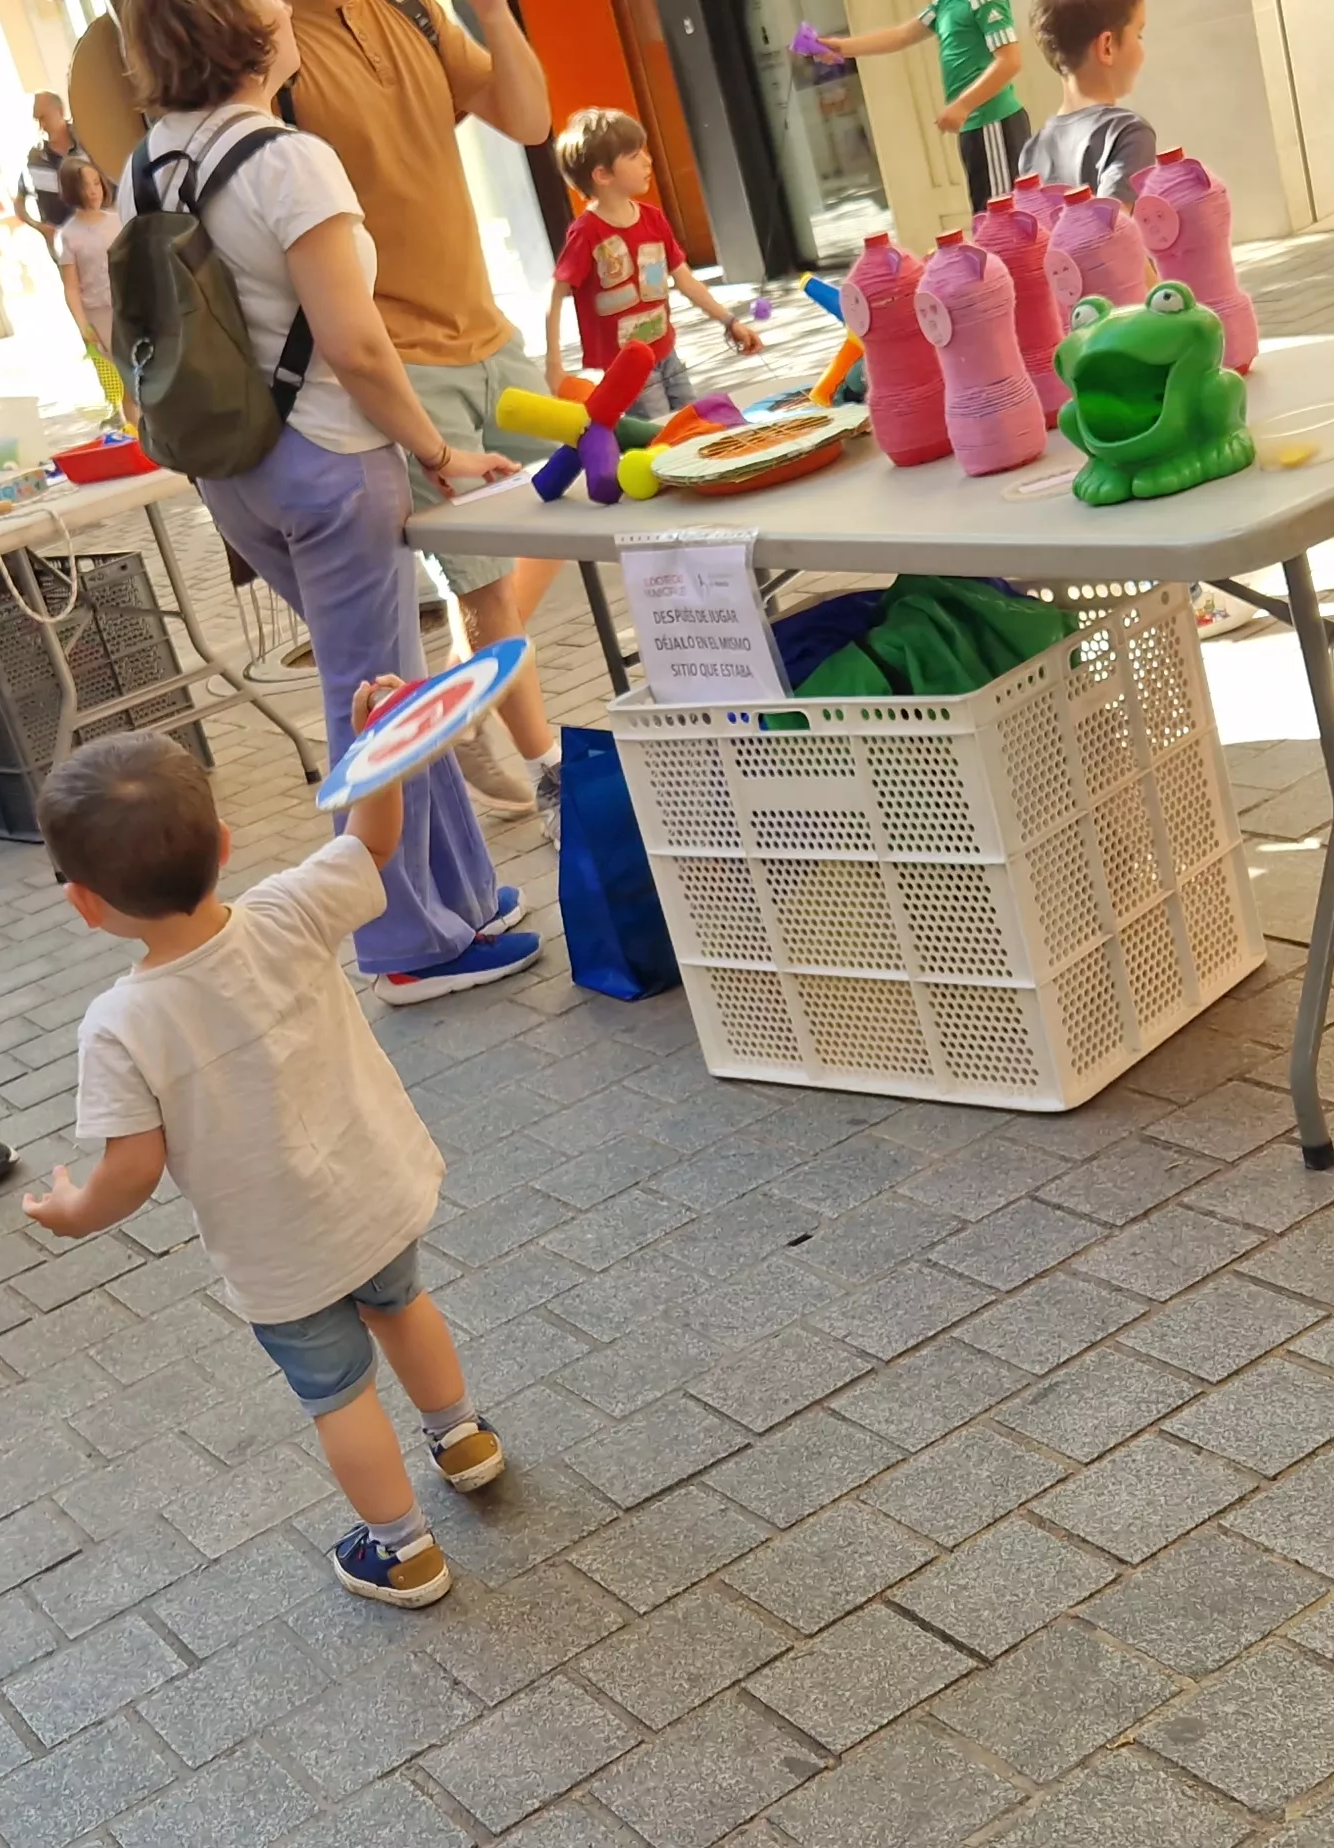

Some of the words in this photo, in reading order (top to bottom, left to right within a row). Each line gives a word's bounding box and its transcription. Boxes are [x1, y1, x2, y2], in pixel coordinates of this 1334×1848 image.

[652, 606, 695, 624] DESPUÉS
[696, 609, 708, 623] DE
[708, 608, 739, 623] JUGAR
[654, 633, 695, 651] DÉJALO
[696, 636, 708, 649] EN
[708, 636, 719, 649] EL
[718, 636, 751, 651] MISMO
[670, 662, 697, 677] SITIO
[699, 662, 720, 677] QUE
[720, 663, 753, 678] ESTABA
